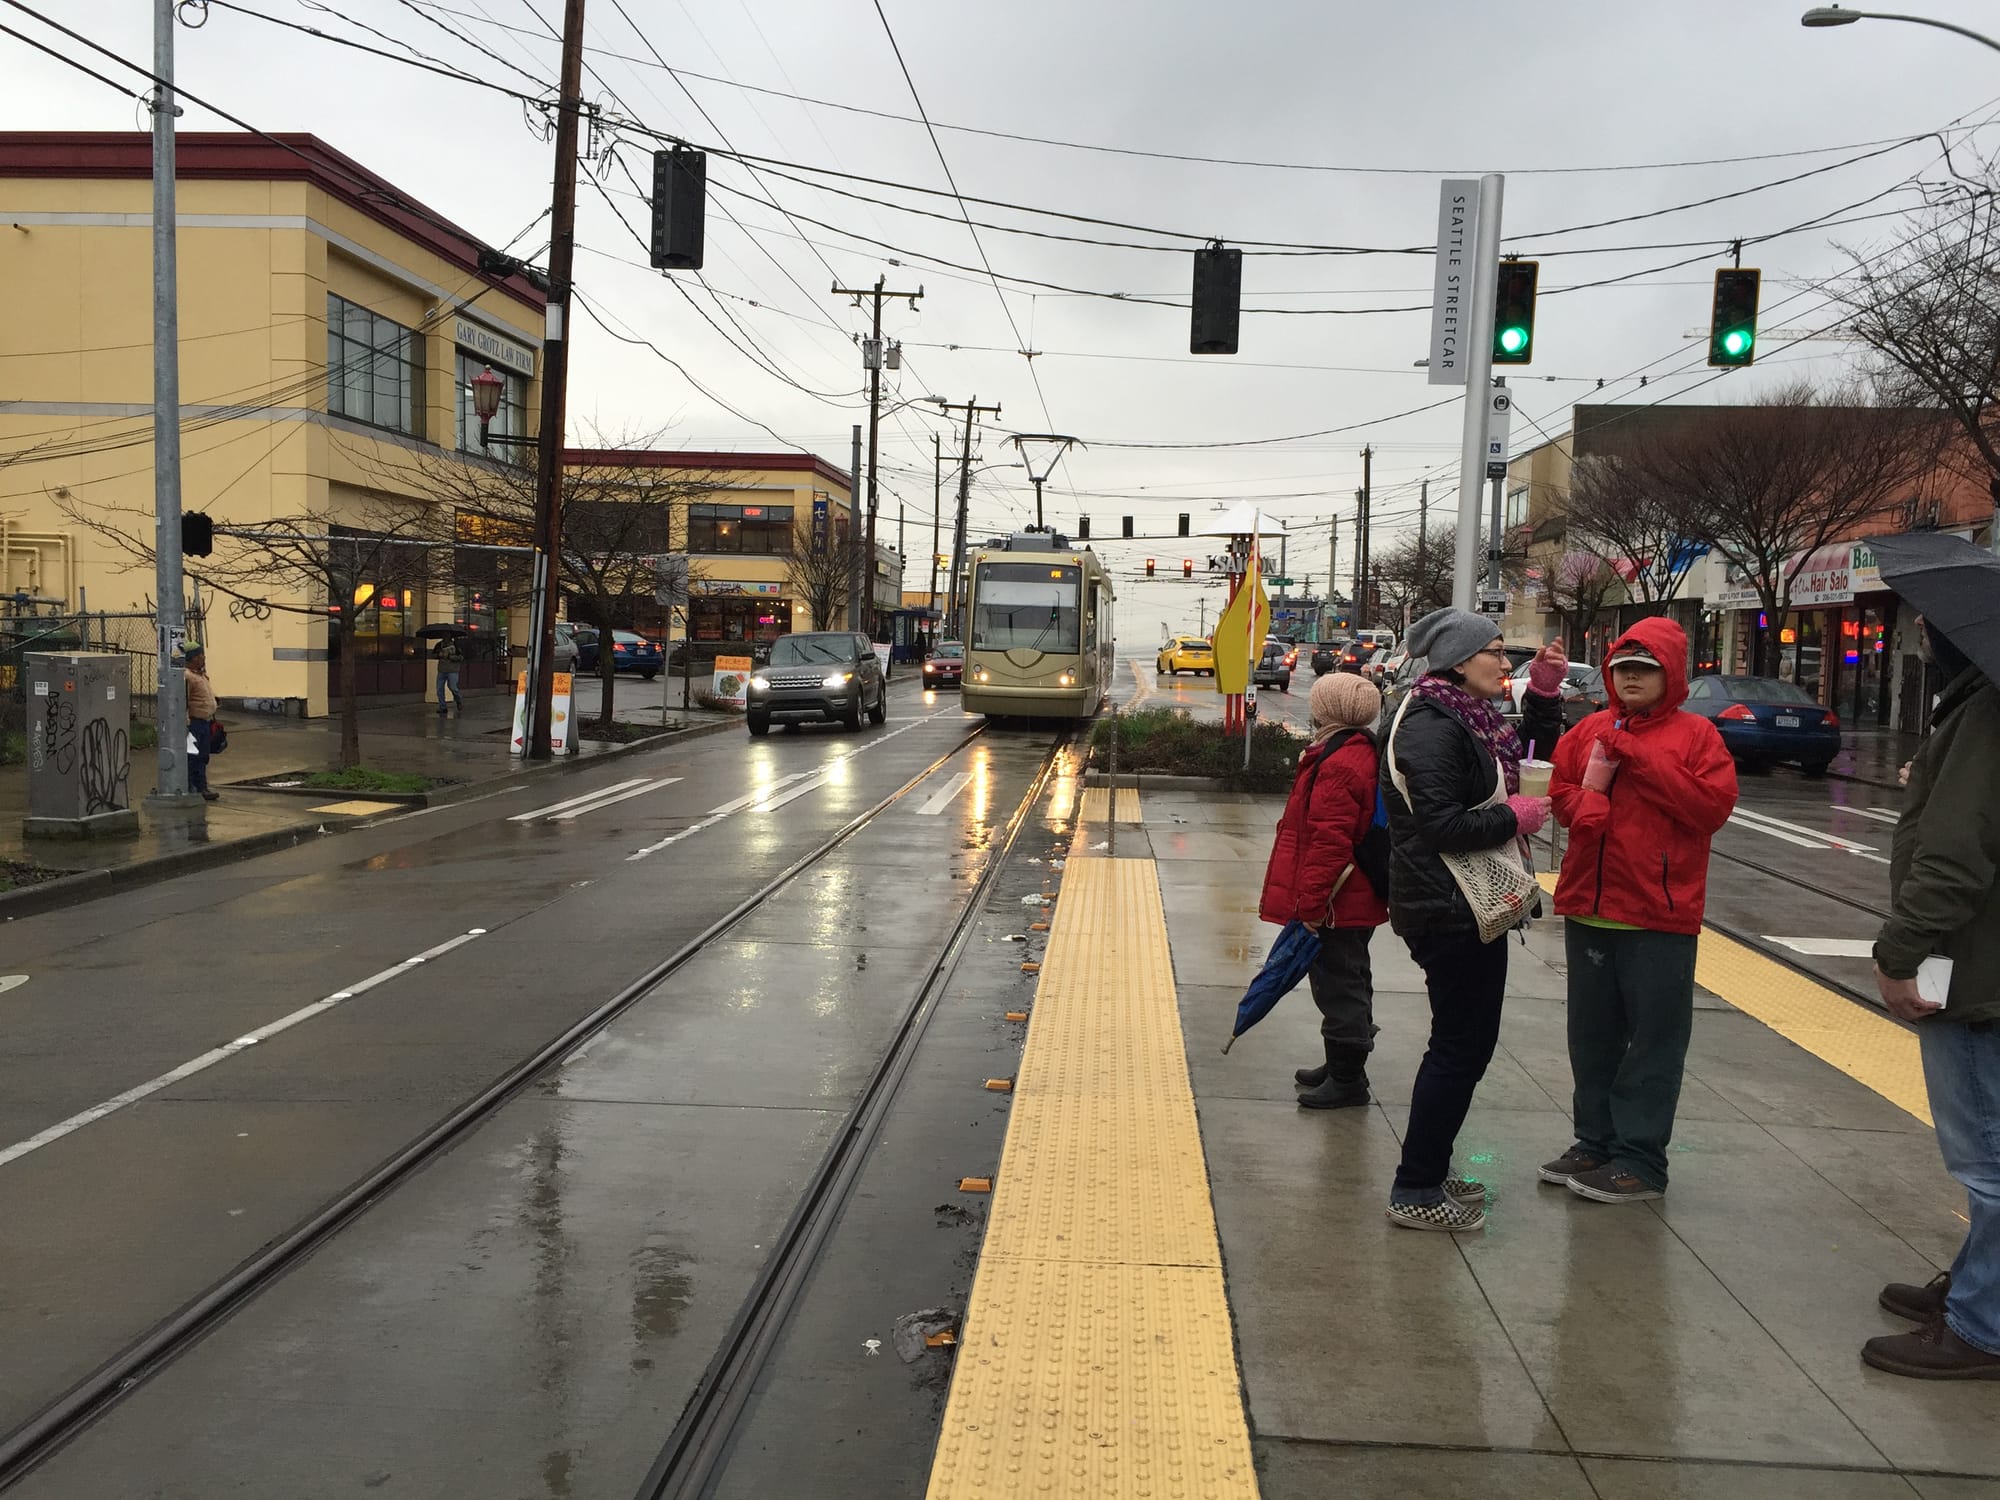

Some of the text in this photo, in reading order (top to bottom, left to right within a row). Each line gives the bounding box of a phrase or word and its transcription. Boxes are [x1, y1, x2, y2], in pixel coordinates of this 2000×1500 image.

[1441, 196, 1465, 369] SEATTLE STREETCAR
[457, 322, 532, 373] GARY GROTZ LAW FIRM
[1810, 573, 1828, 593] Hair
